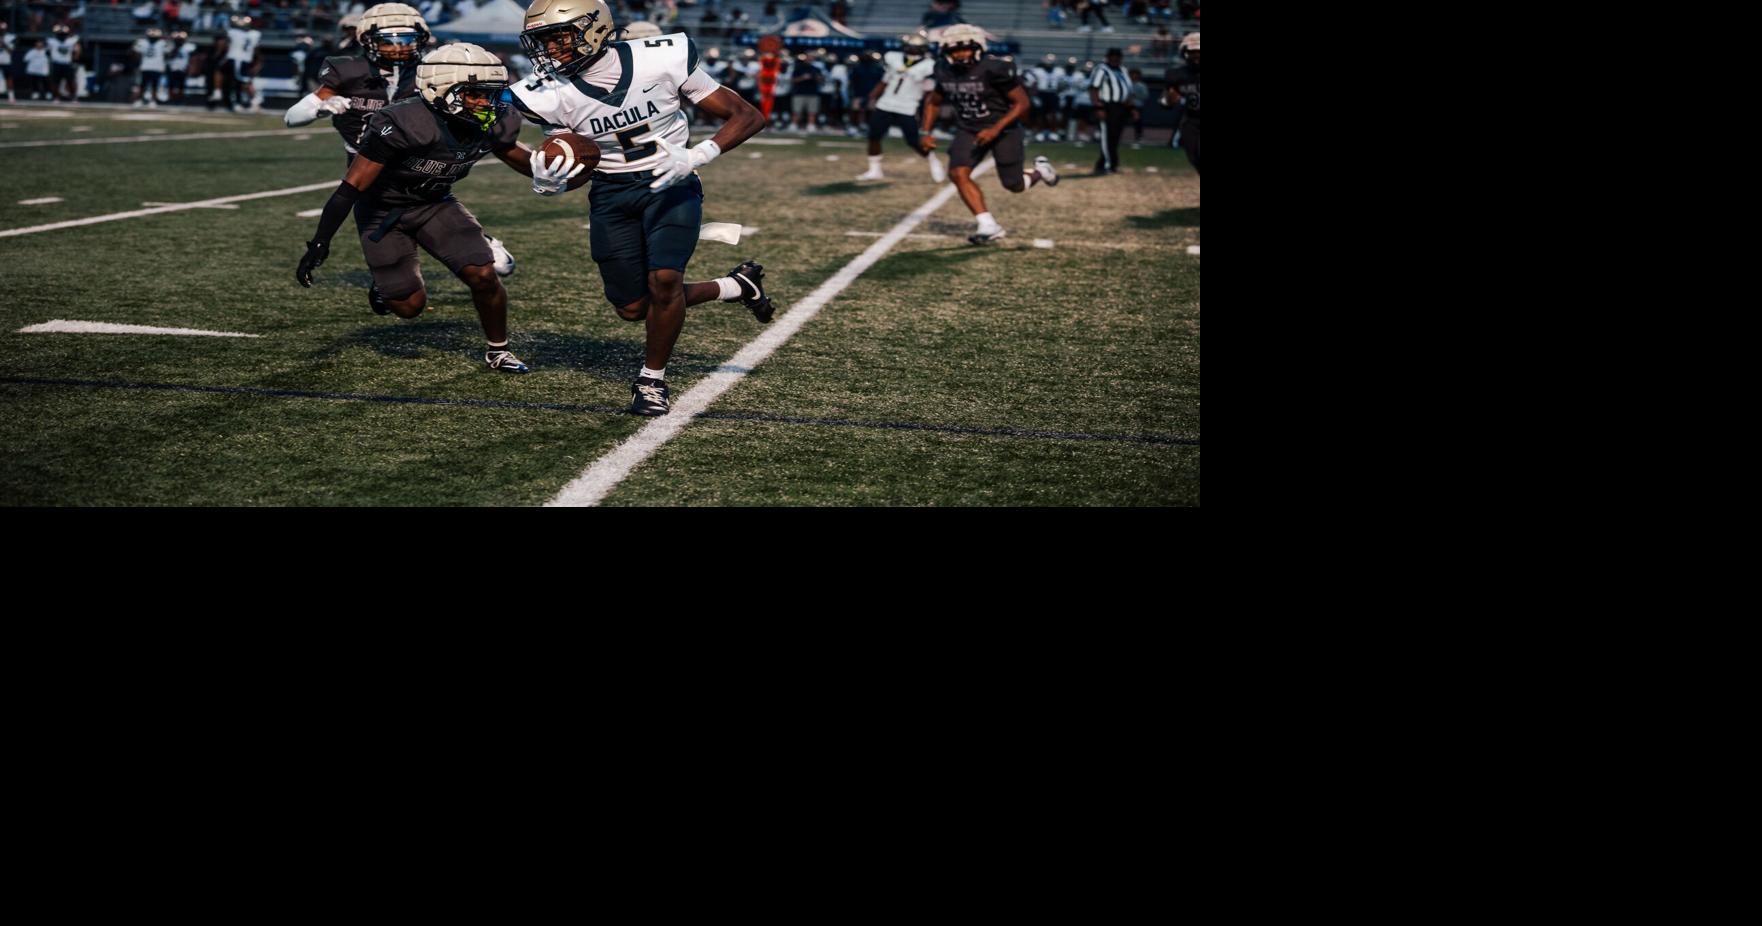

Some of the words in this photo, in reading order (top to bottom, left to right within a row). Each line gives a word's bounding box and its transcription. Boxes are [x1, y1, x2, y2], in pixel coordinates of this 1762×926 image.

[644, 38, 673, 48] 5
[589, 100, 660, 135] DACULA
[616, 123, 658, 163] 5
